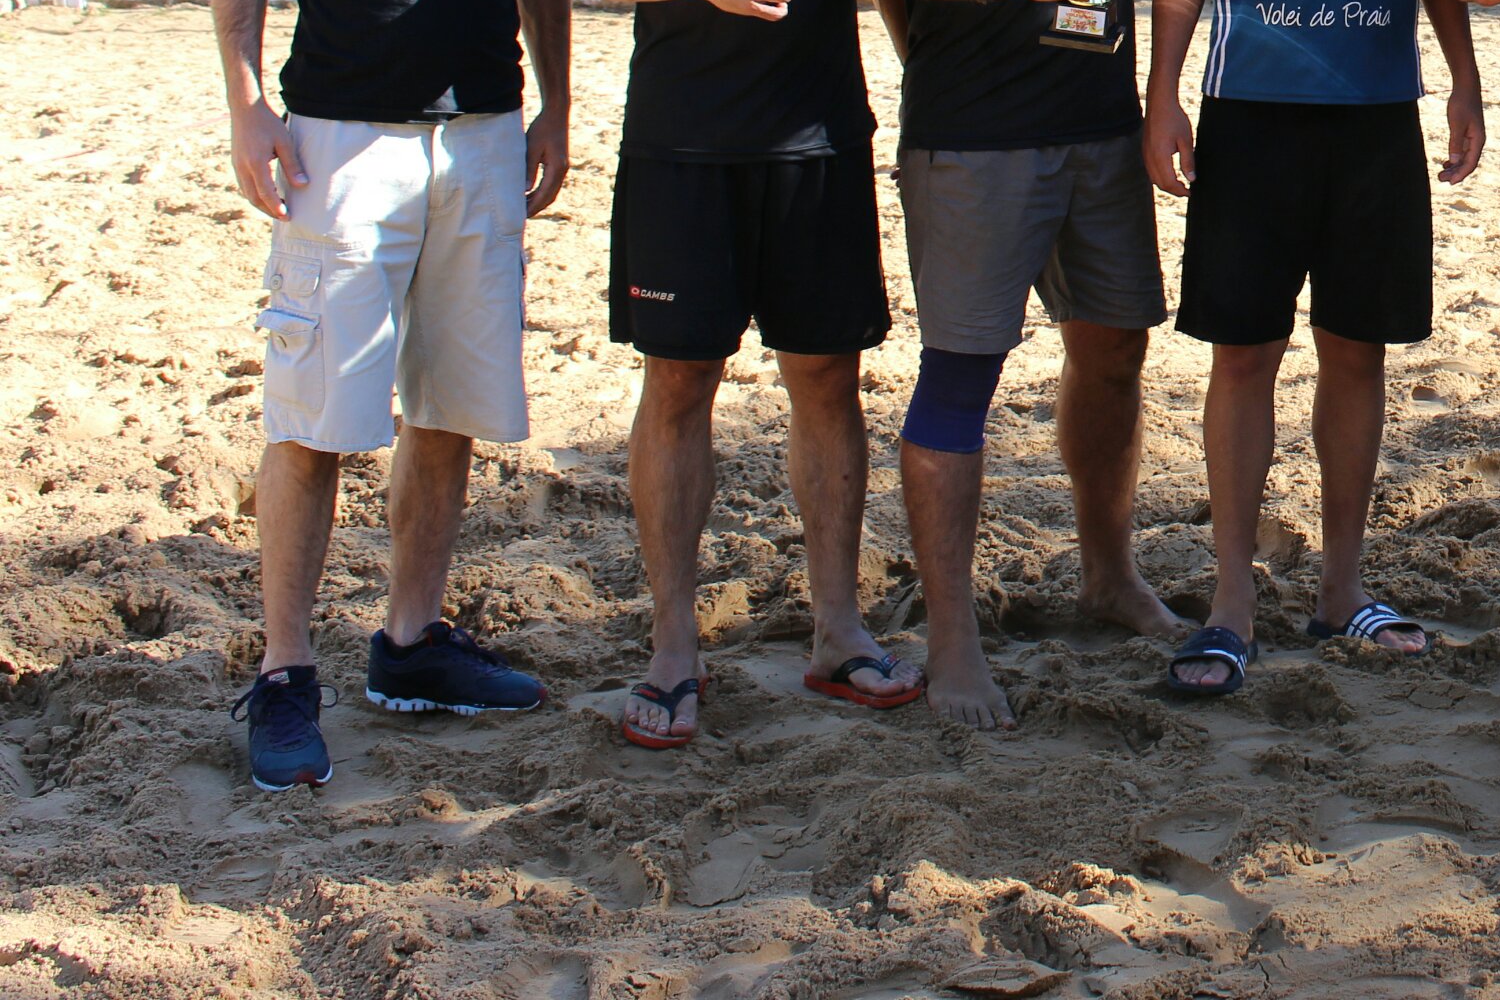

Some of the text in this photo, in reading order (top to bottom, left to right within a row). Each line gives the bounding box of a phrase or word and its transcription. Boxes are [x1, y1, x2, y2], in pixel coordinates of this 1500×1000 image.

[1256, 1, 1391, 28] Volei de Praia
